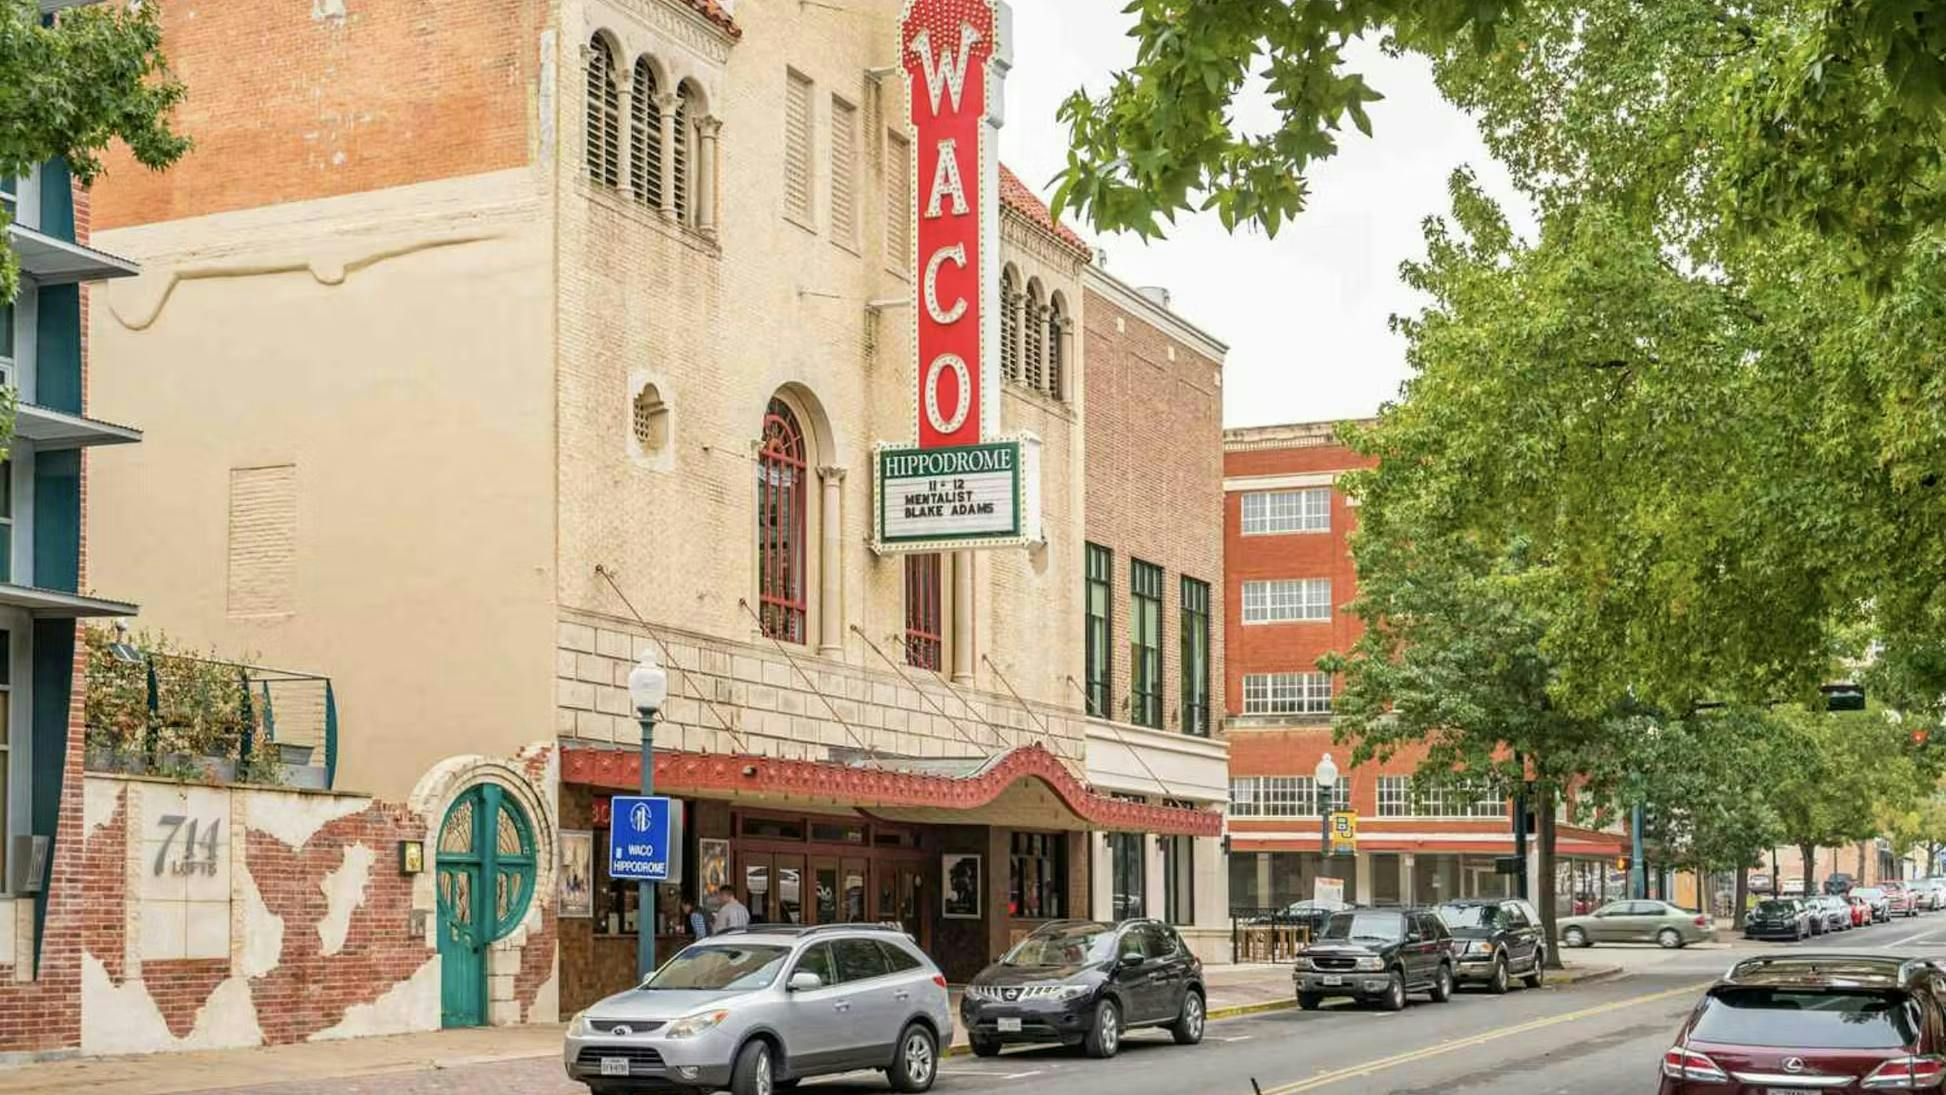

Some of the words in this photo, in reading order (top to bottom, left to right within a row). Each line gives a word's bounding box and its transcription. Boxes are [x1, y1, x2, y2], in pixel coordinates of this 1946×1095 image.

[909, 21, 983, 434] WACO
[885, 448, 1012, 477] HIPPODROME
[953, 479, 965, 490] 12
[904, 491, 973, 505] MENTALIST
[904, 505, 943, 519] BLAKE
[951, 503, 994, 516] ADAMS
[154, 814, 221, 876] 714
[628, 844, 653, 857] WACO
[613, 861, 665, 874] HIPPODROME
